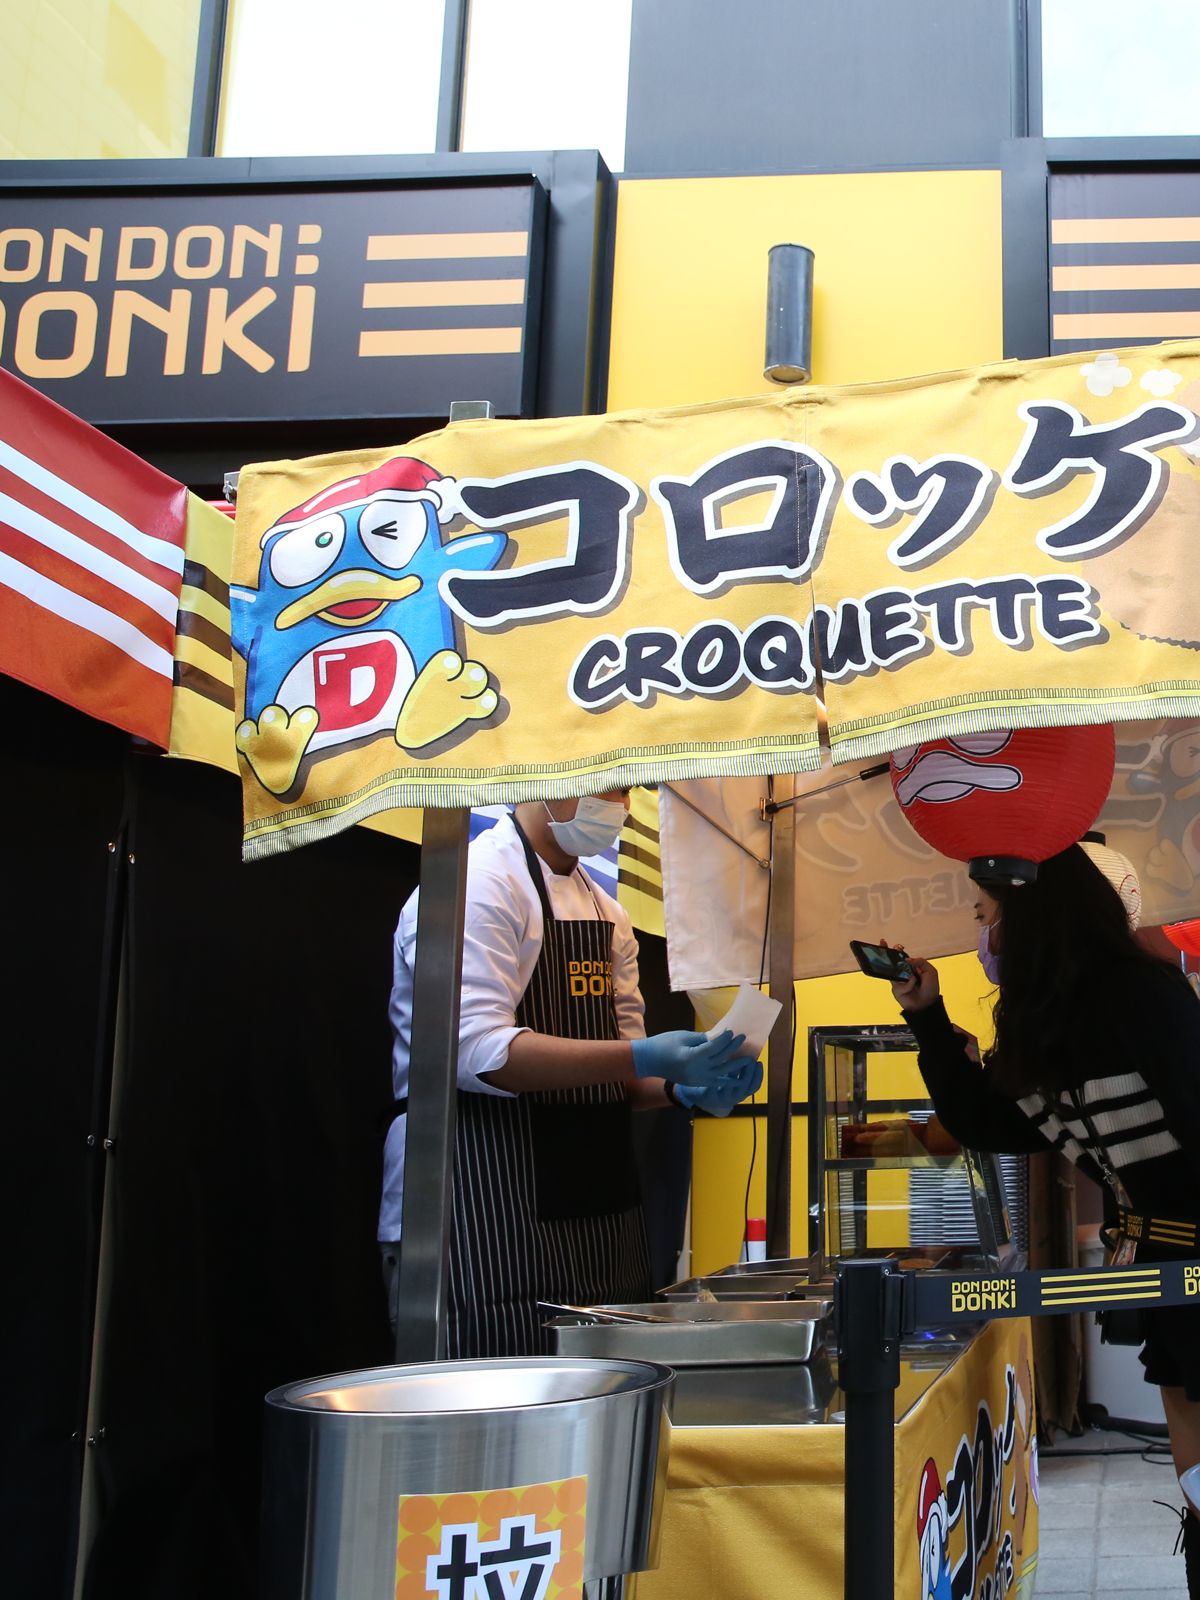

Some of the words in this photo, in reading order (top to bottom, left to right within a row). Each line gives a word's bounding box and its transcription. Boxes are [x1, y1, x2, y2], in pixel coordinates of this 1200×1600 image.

[0, 228, 103, 282] ON
[0, 286, 316, 379] ONKI
[447, 405, 1190, 618] コロッケ
[572, 578, 1099, 702] CROQUETTE
[313, 639, 397, 732] D
[569, 961, 603, 975] DON
[952, 1281, 979, 1293] DON
[952, 1291, 1015, 1312] DONKI
